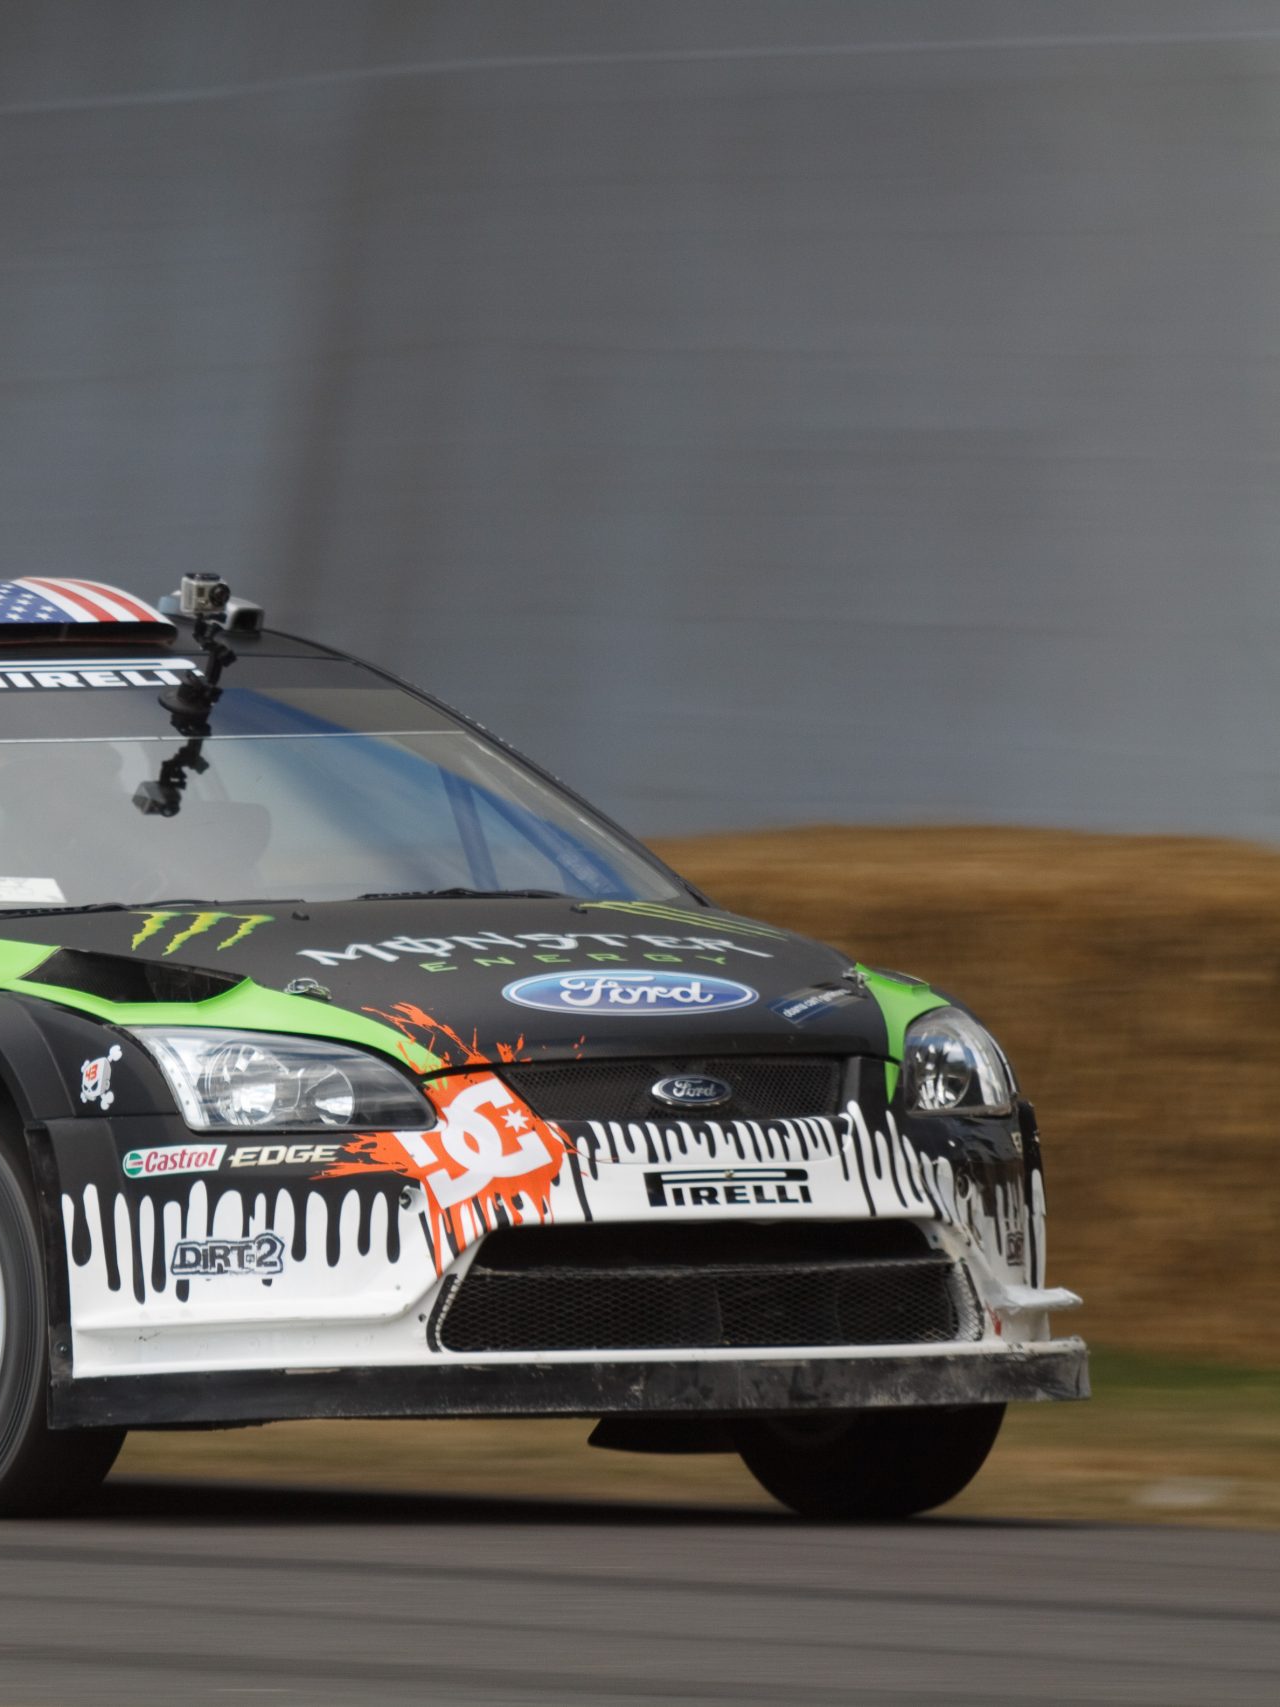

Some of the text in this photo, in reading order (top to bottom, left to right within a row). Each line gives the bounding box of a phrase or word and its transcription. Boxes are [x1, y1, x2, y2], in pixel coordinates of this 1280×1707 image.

[419, 953, 726, 973] ENERGY
[559, 976, 714, 1006] Ford
[84, 1063, 99, 1081] 43
[672, 1079, 716, 1098] Ford
[144, 1144, 342, 1173] Castrol EDGE
[643, 1168, 813, 1208] PIRELLI
[255, 1237, 278, 1268] 2
